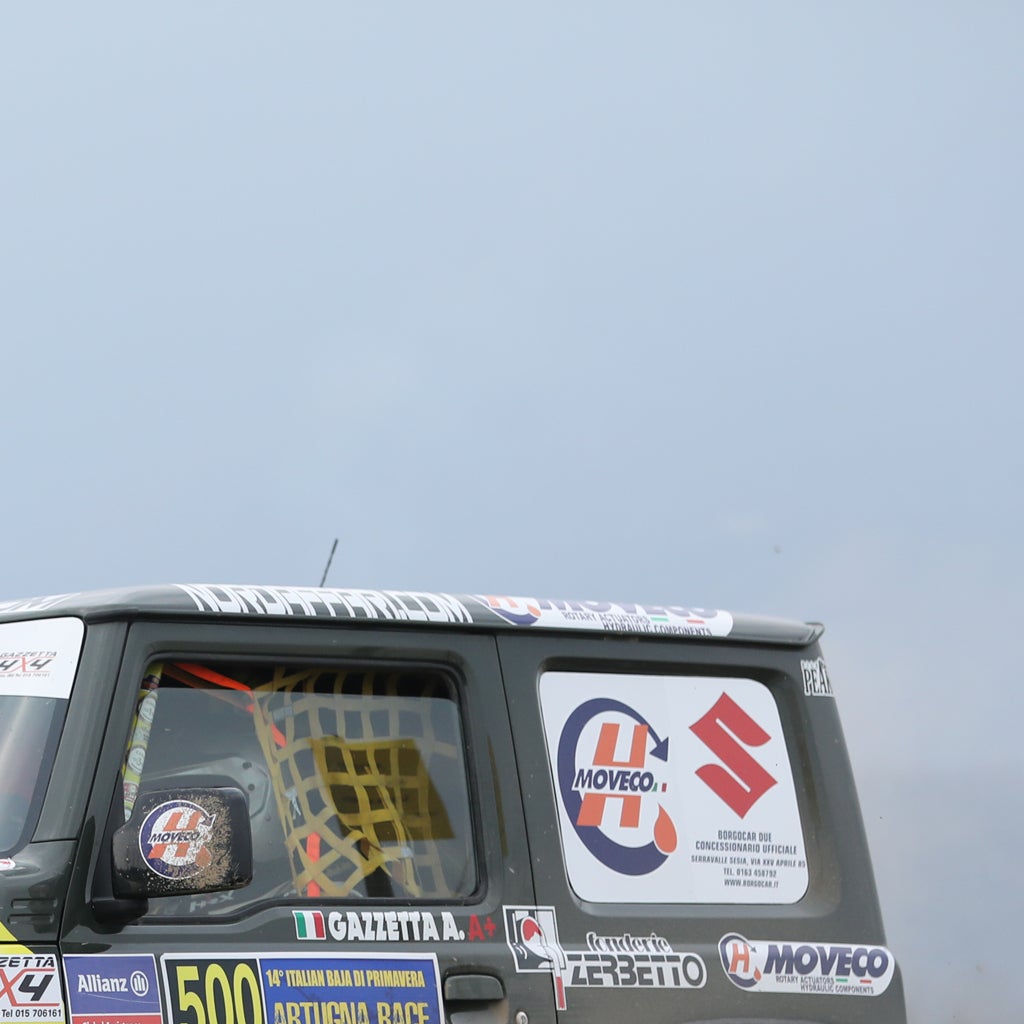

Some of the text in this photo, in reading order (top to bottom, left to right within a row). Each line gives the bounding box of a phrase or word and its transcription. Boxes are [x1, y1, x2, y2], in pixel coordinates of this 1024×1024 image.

[654, 625, 713, 636] COMPONENTS
[574, 768, 654, 792] MOVECO
[718, 830, 772, 842] BORGOCAR DUE
[695, 841, 797, 855] CONCESSIONARIO UFFICIALE
[691, 855, 727, 864] SERRAVALLE
[762, 859, 774, 867] XXV
[328, 911, 439, 941] GAZZETTA
[443, 911, 466, 941] A.
[763, 944, 889, 978] MOVECO
[567, 954, 704, 986] ZERBETTO
[78, 974, 128, 993] Allianz
[286, 970, 325, 987] ITALIAN
[326, 970, 353, 987] BAJA
[353, 970, 366, 987] DI
[366, 970, 425, 987] PRIMAVERA
[776, 975, 835, 985] ROTARY ACTUATORS
[800, 984, 874, 994] HYDRAULIC COMPONENTS
[1, 1009, 13, 1018] Tel
[15, 1009, 30, 1018] 015
[32, 1008, 62, 1018] 706161
